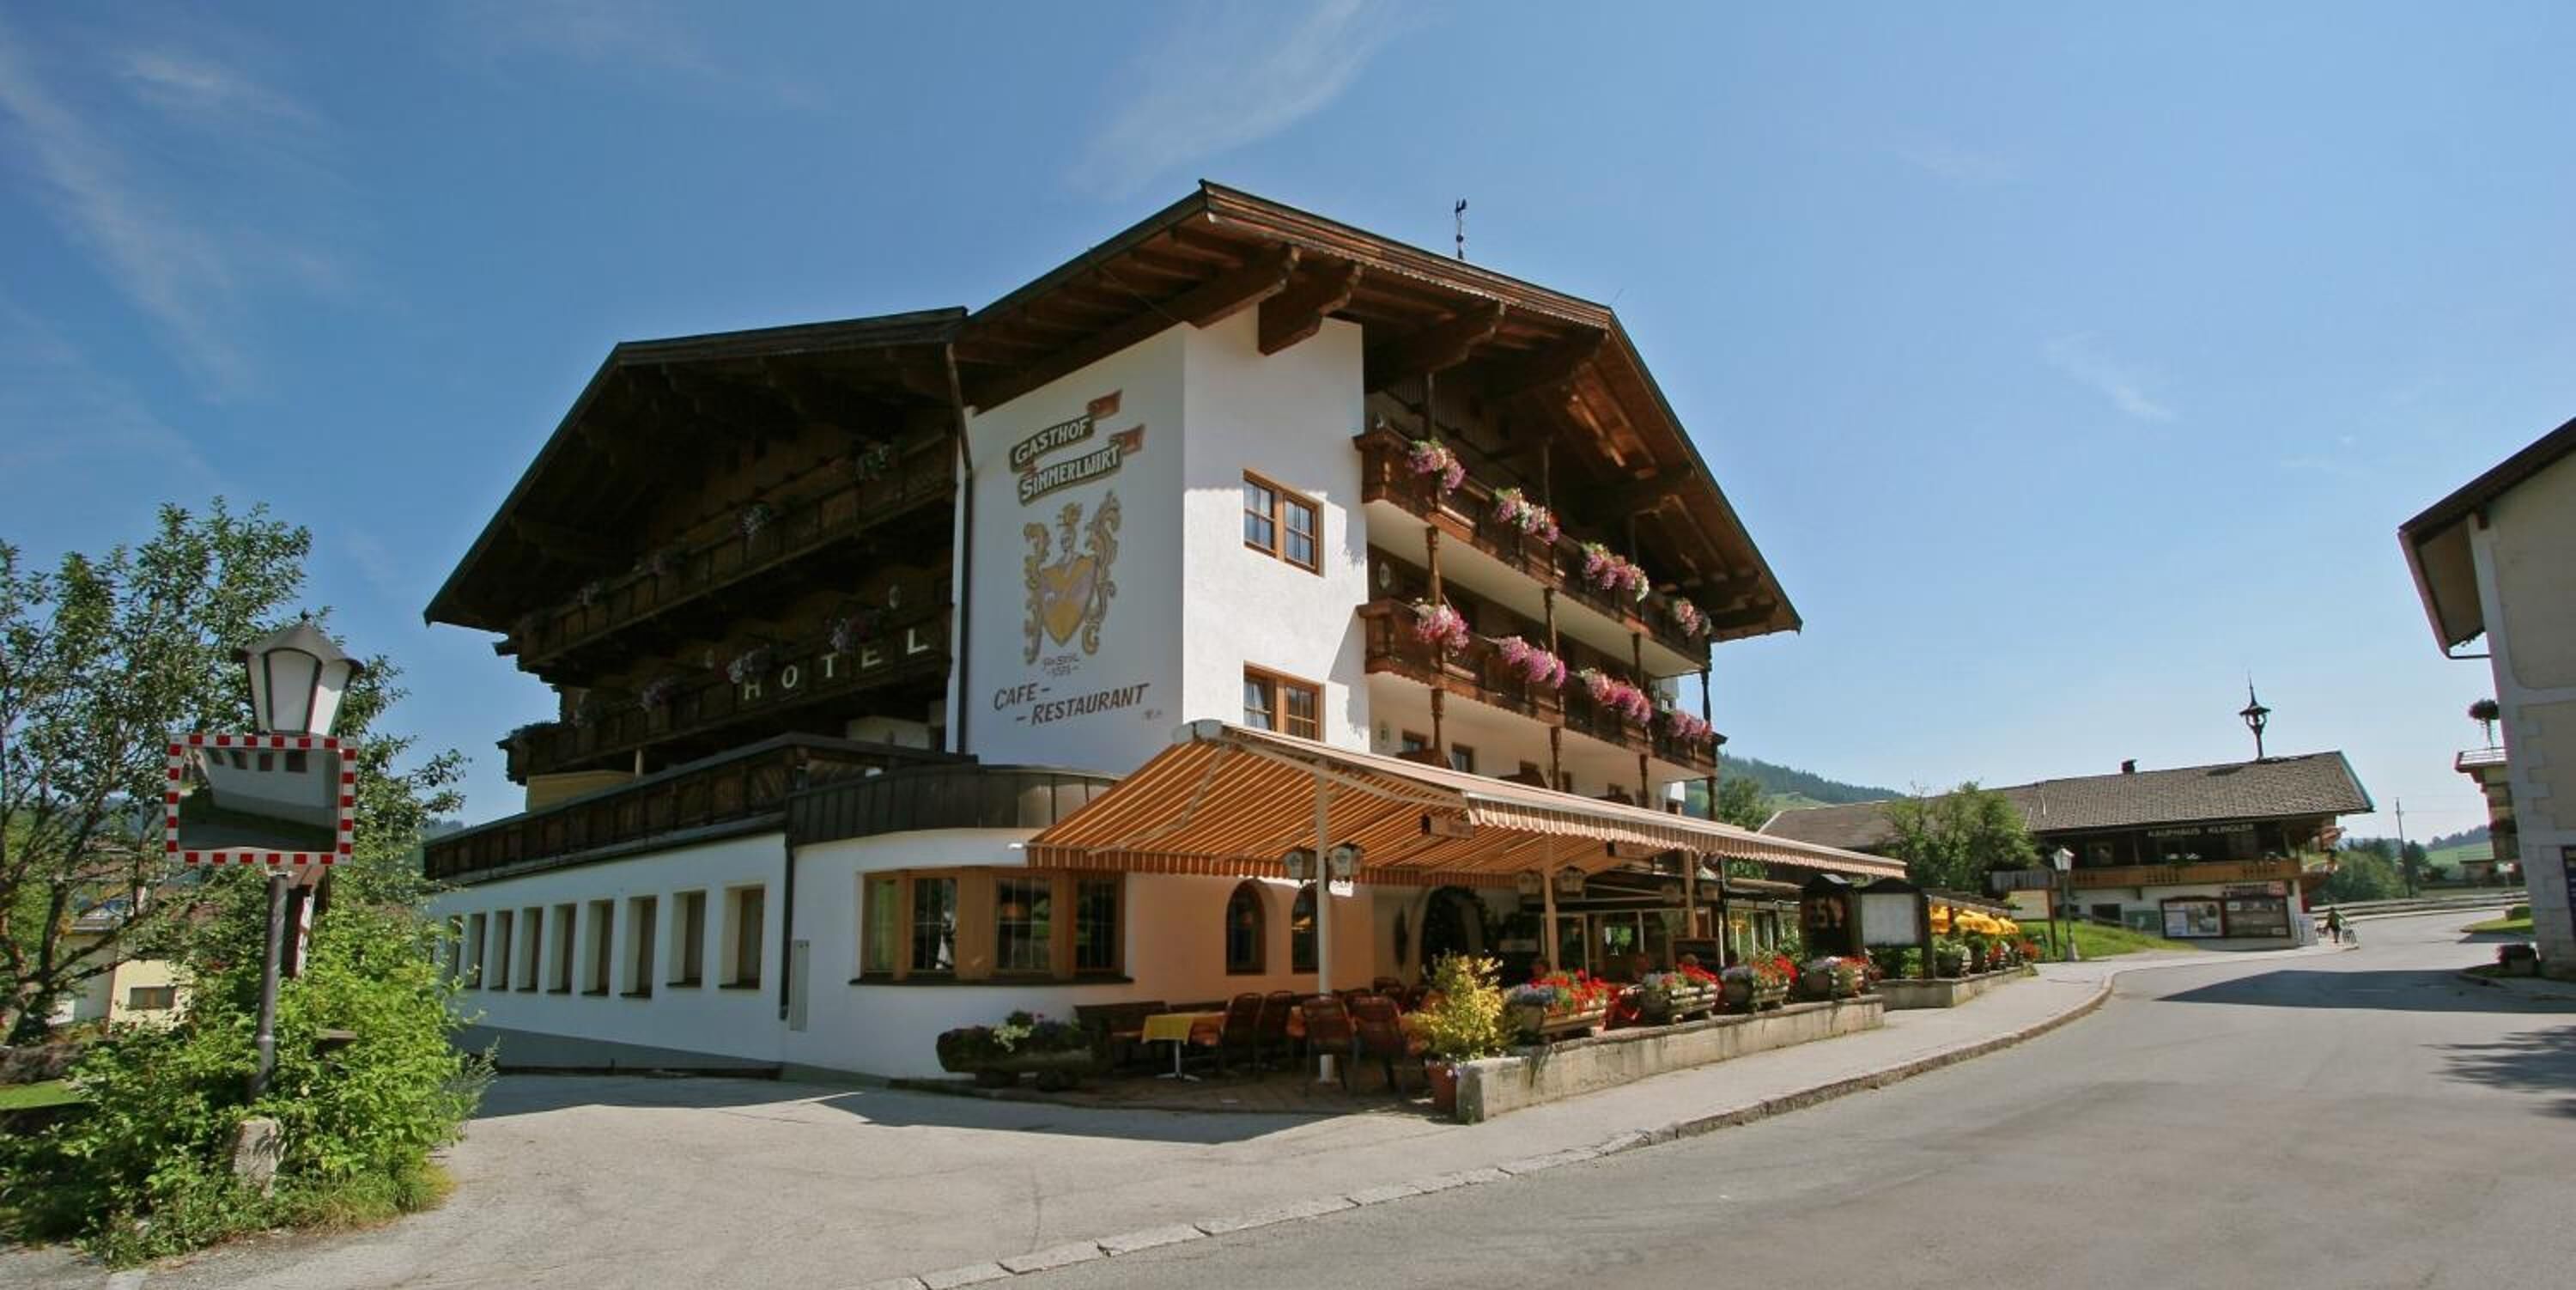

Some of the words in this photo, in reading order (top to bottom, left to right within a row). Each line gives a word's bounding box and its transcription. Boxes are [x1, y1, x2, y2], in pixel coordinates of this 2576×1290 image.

[1014, 417, 1091, 464] GASTHOF
[1020, 444, 1121, 500] SIMMERLWIRT
[744, 628, 928, 700] HOTEL
